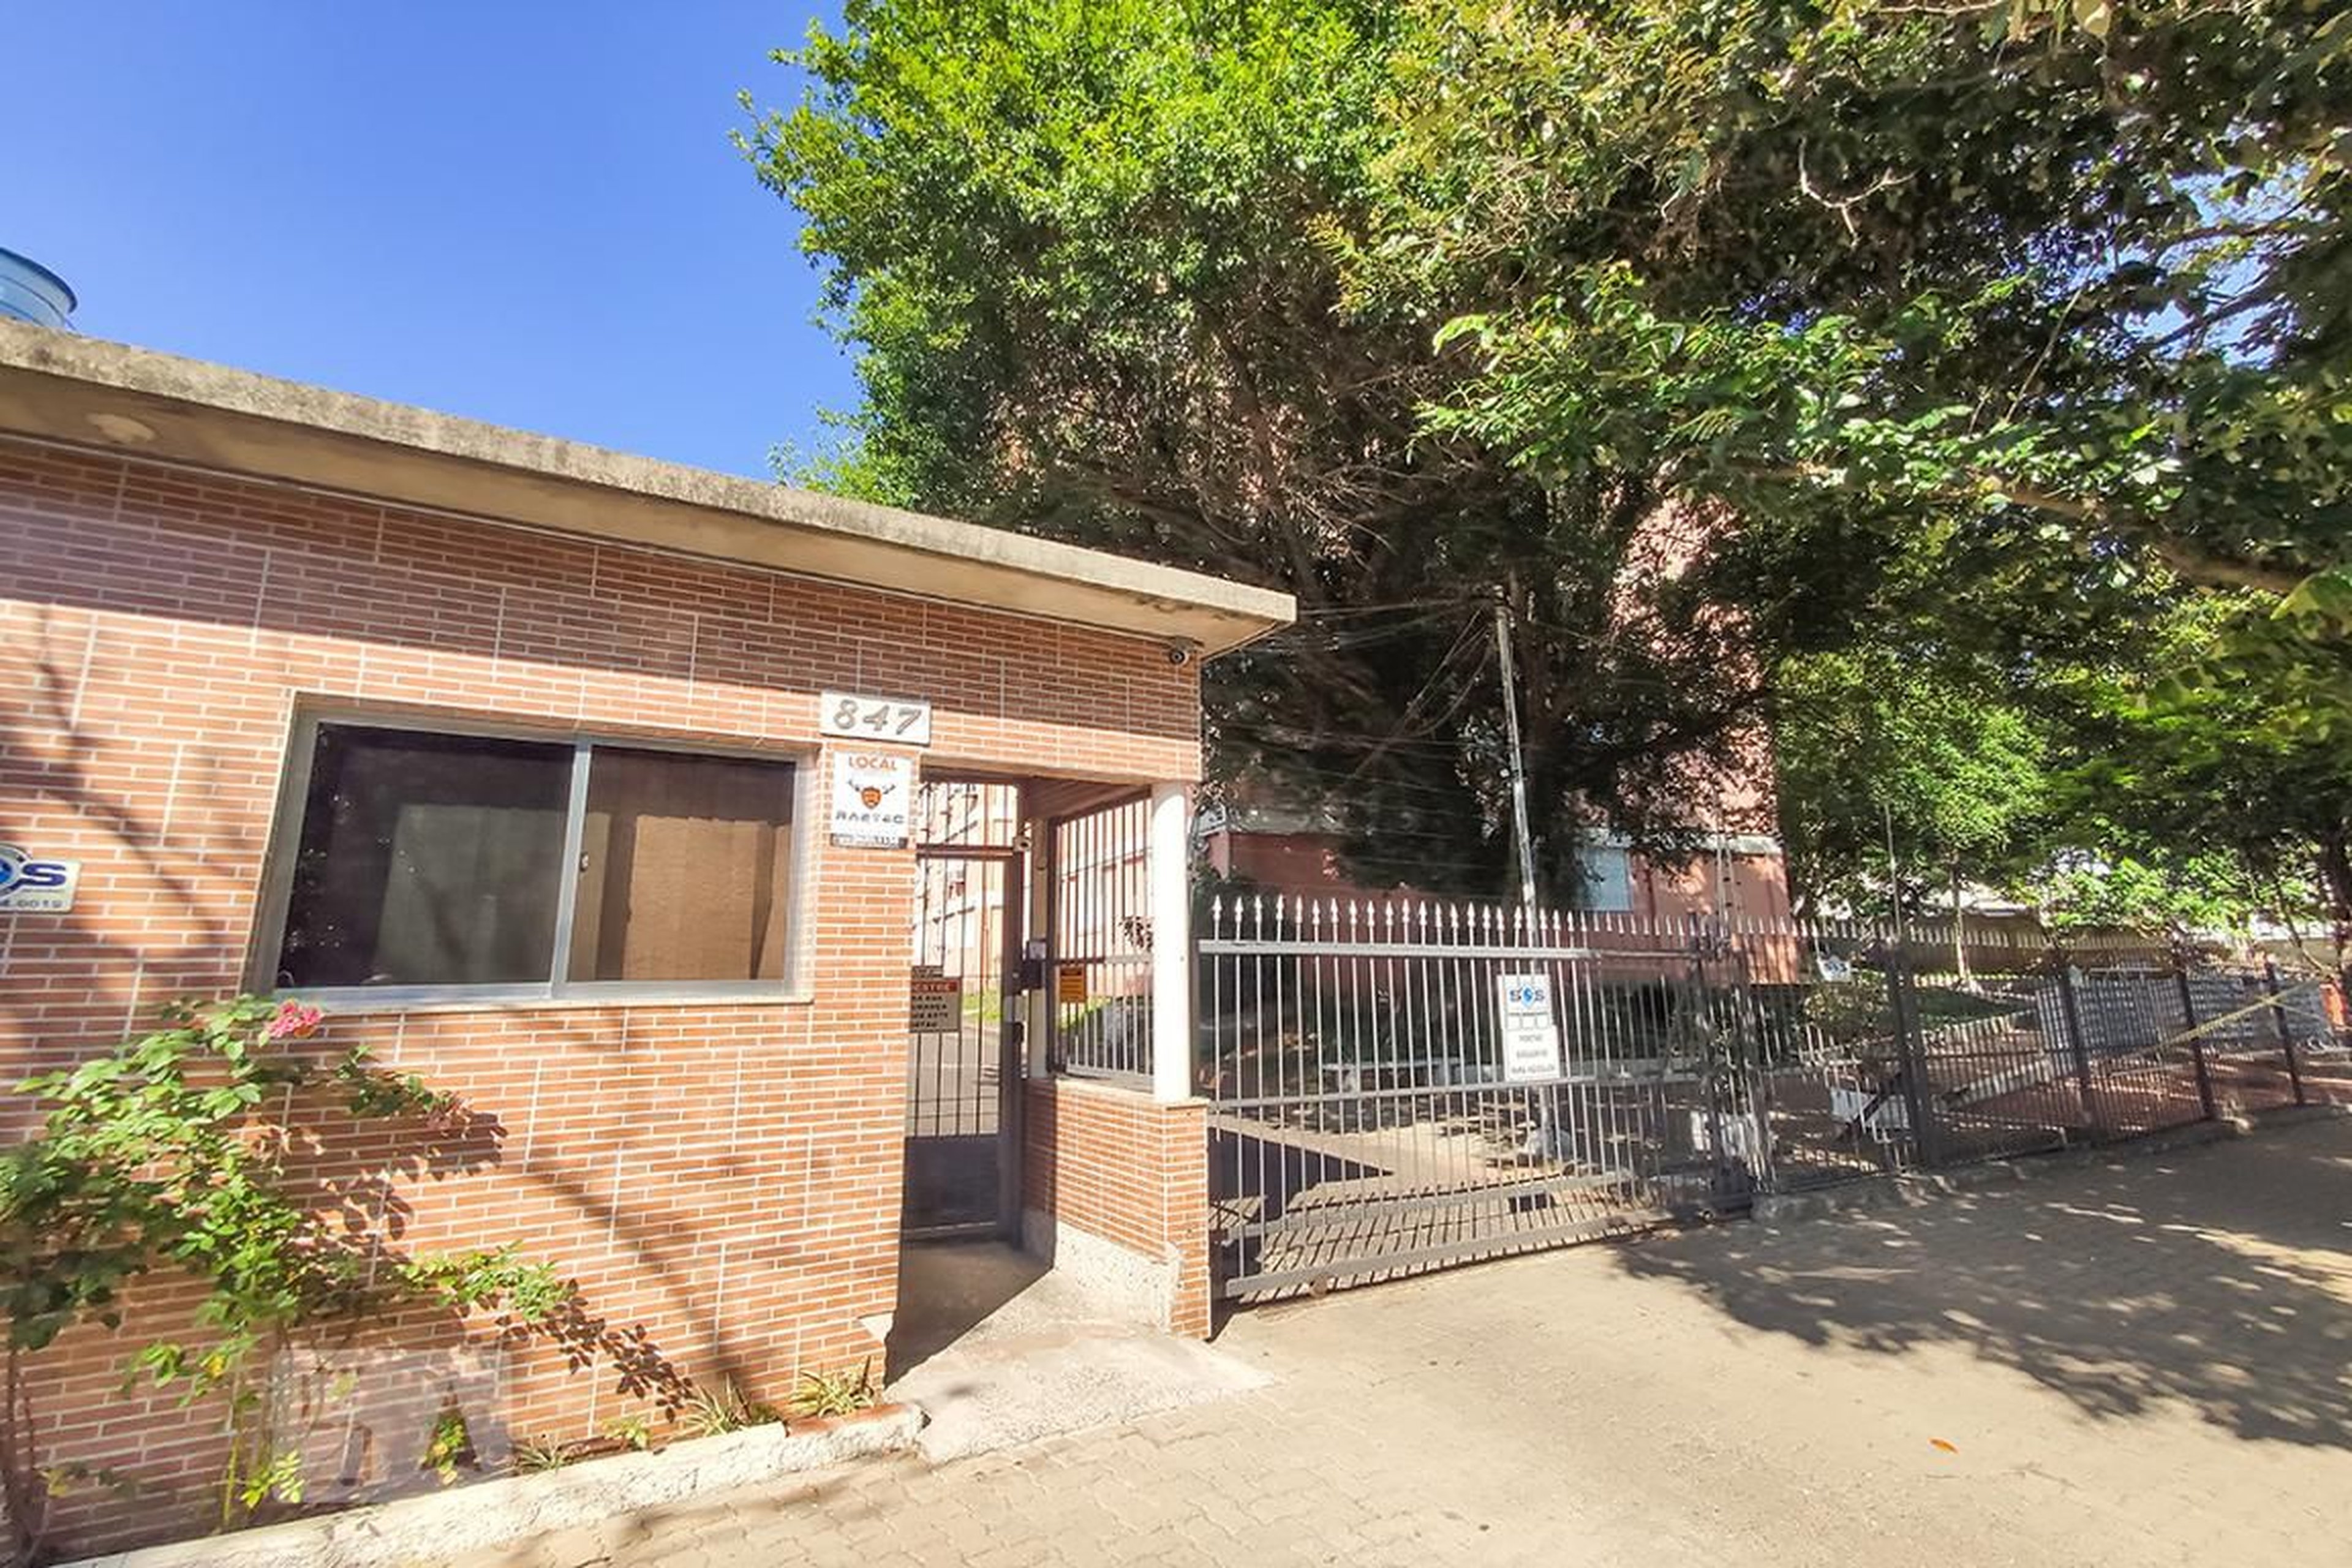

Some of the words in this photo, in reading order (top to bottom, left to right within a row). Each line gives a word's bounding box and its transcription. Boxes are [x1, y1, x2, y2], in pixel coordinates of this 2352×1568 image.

[834, 699, 922, 735] 847
[849, 756, 897, 771] LOCAL
[1509, 986, 1545, 1005] SOS
